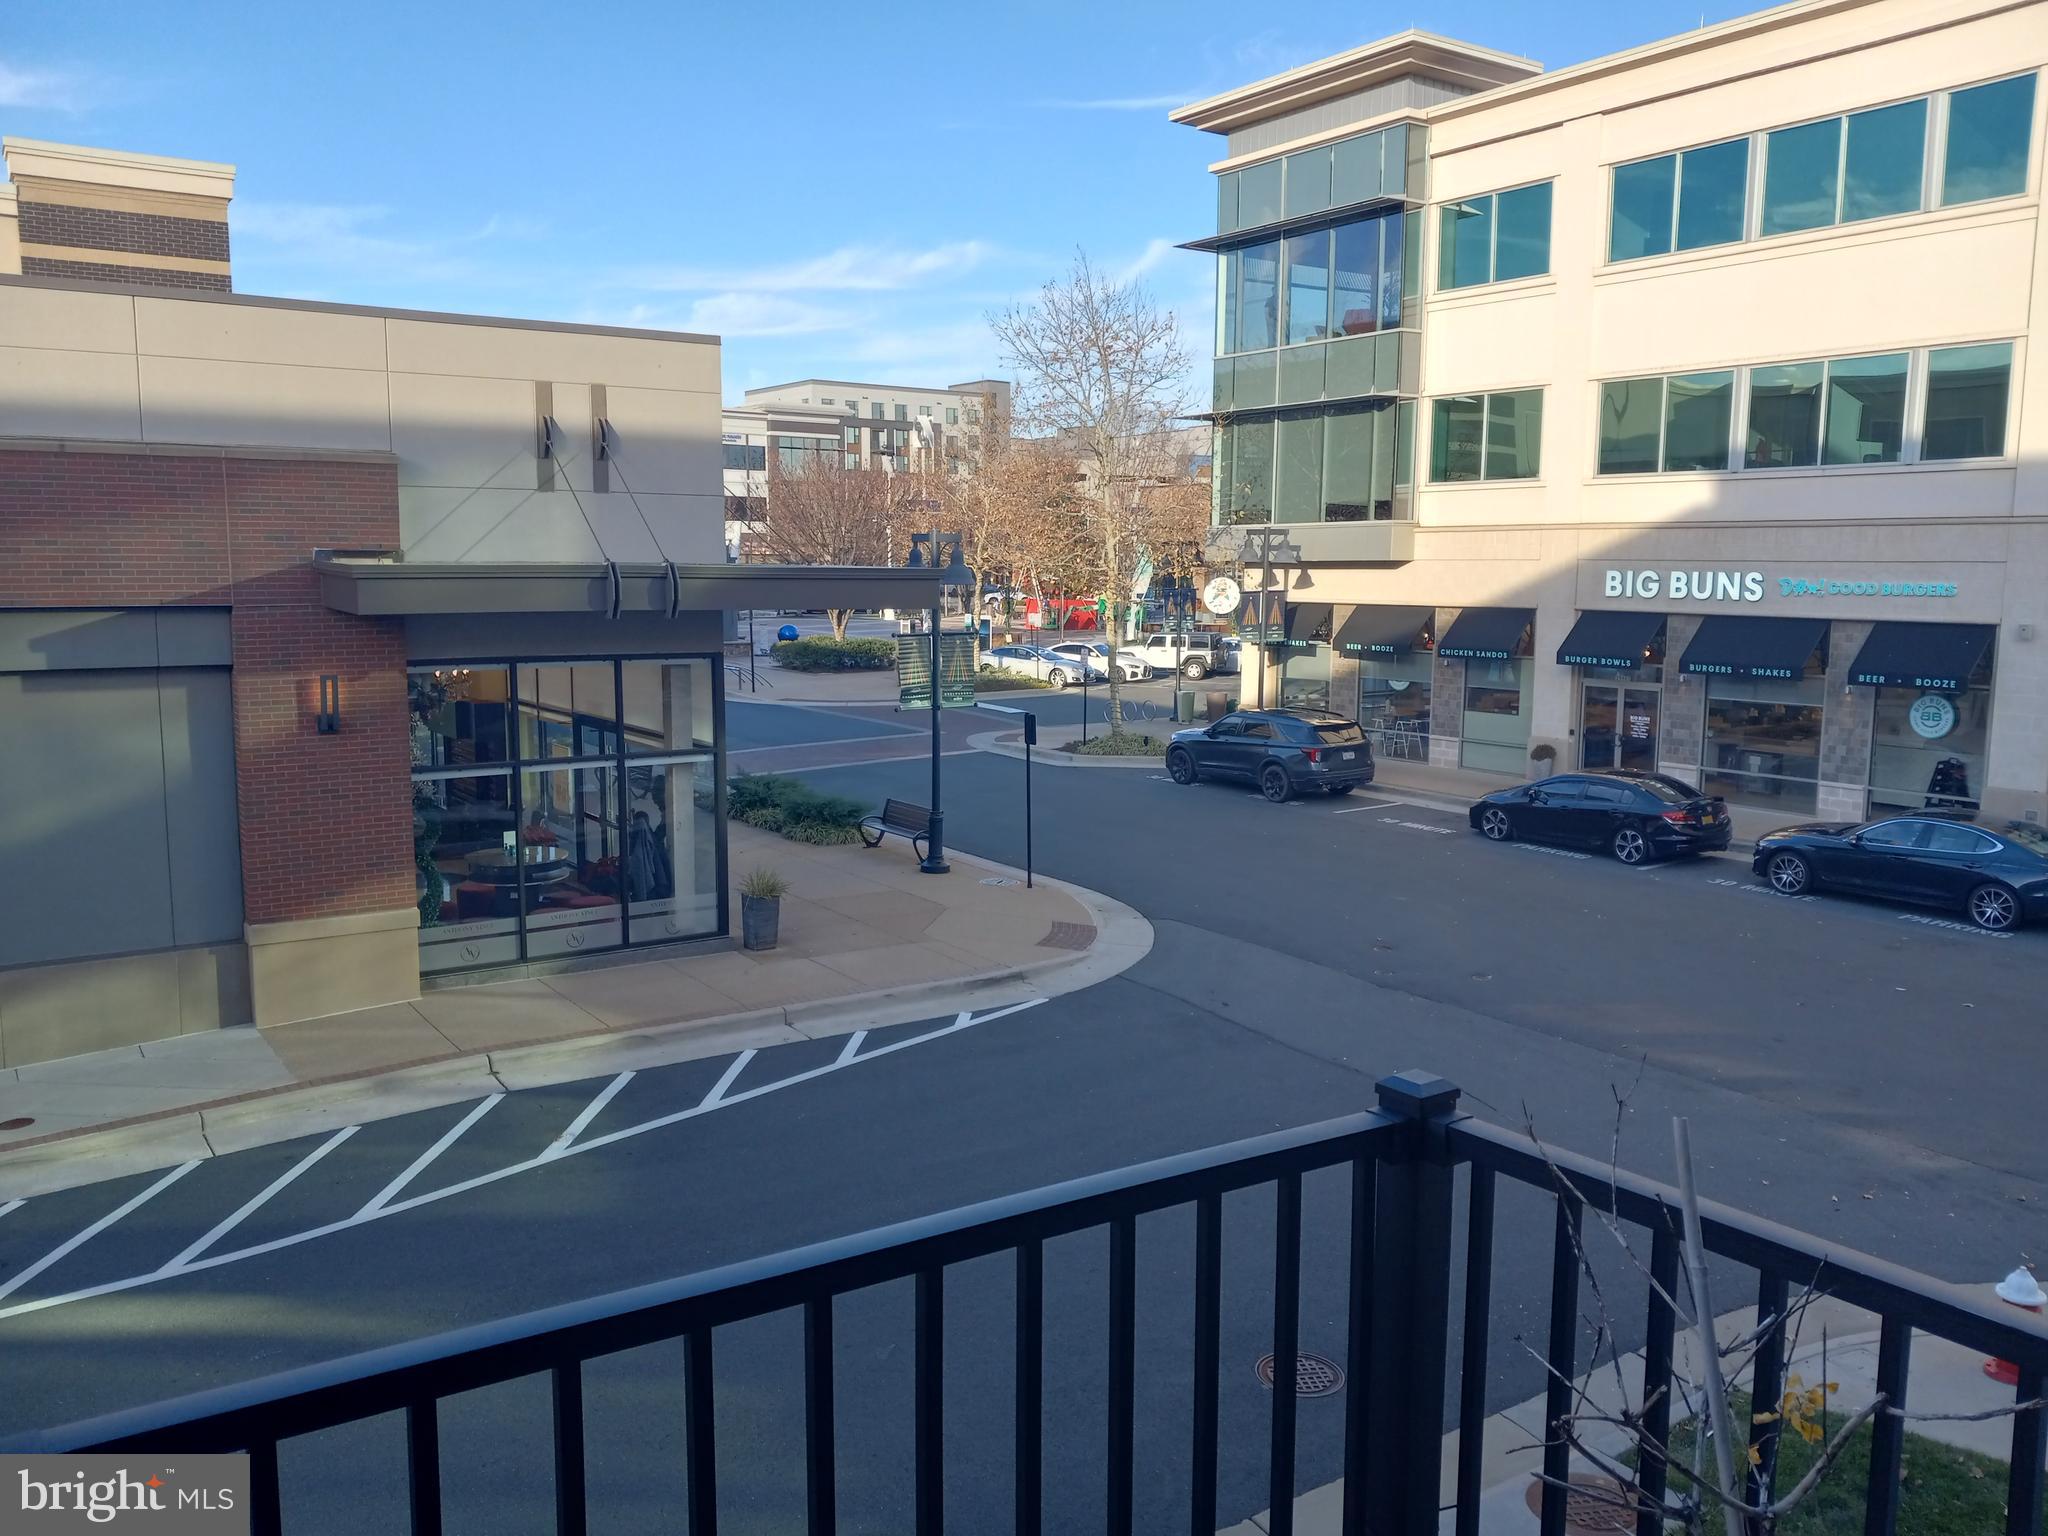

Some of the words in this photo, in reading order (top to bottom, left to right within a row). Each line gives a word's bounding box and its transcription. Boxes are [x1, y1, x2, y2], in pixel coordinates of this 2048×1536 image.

[1604, 570, 1661, 599] BIG
[1669, 571, 1765, 602] BUNS
[1828, 582, 1878, 596] GOOD
[1880, 583, 1958, 598] BURGERS
[1346, 643, 1362, 651] BEER
[1371, 645, 1394, 653] BOOZE
[1440, 648, 1474, 657] CHICKEN
[1476, 650, 1508, 659] SANDOS
[1565, 655, 1598, 665] BURGER
[1601, 658, 1631, 667] BOWLS
[1689, 663, 1733, 674] BURGERS
[1751, 668, 1792, 678] SHAKES
[1859, 674, 1885, 684] BEER
[1915, 678, 1957, 689] BOOZE
[1897, 914, 2015, 938] PARKING
